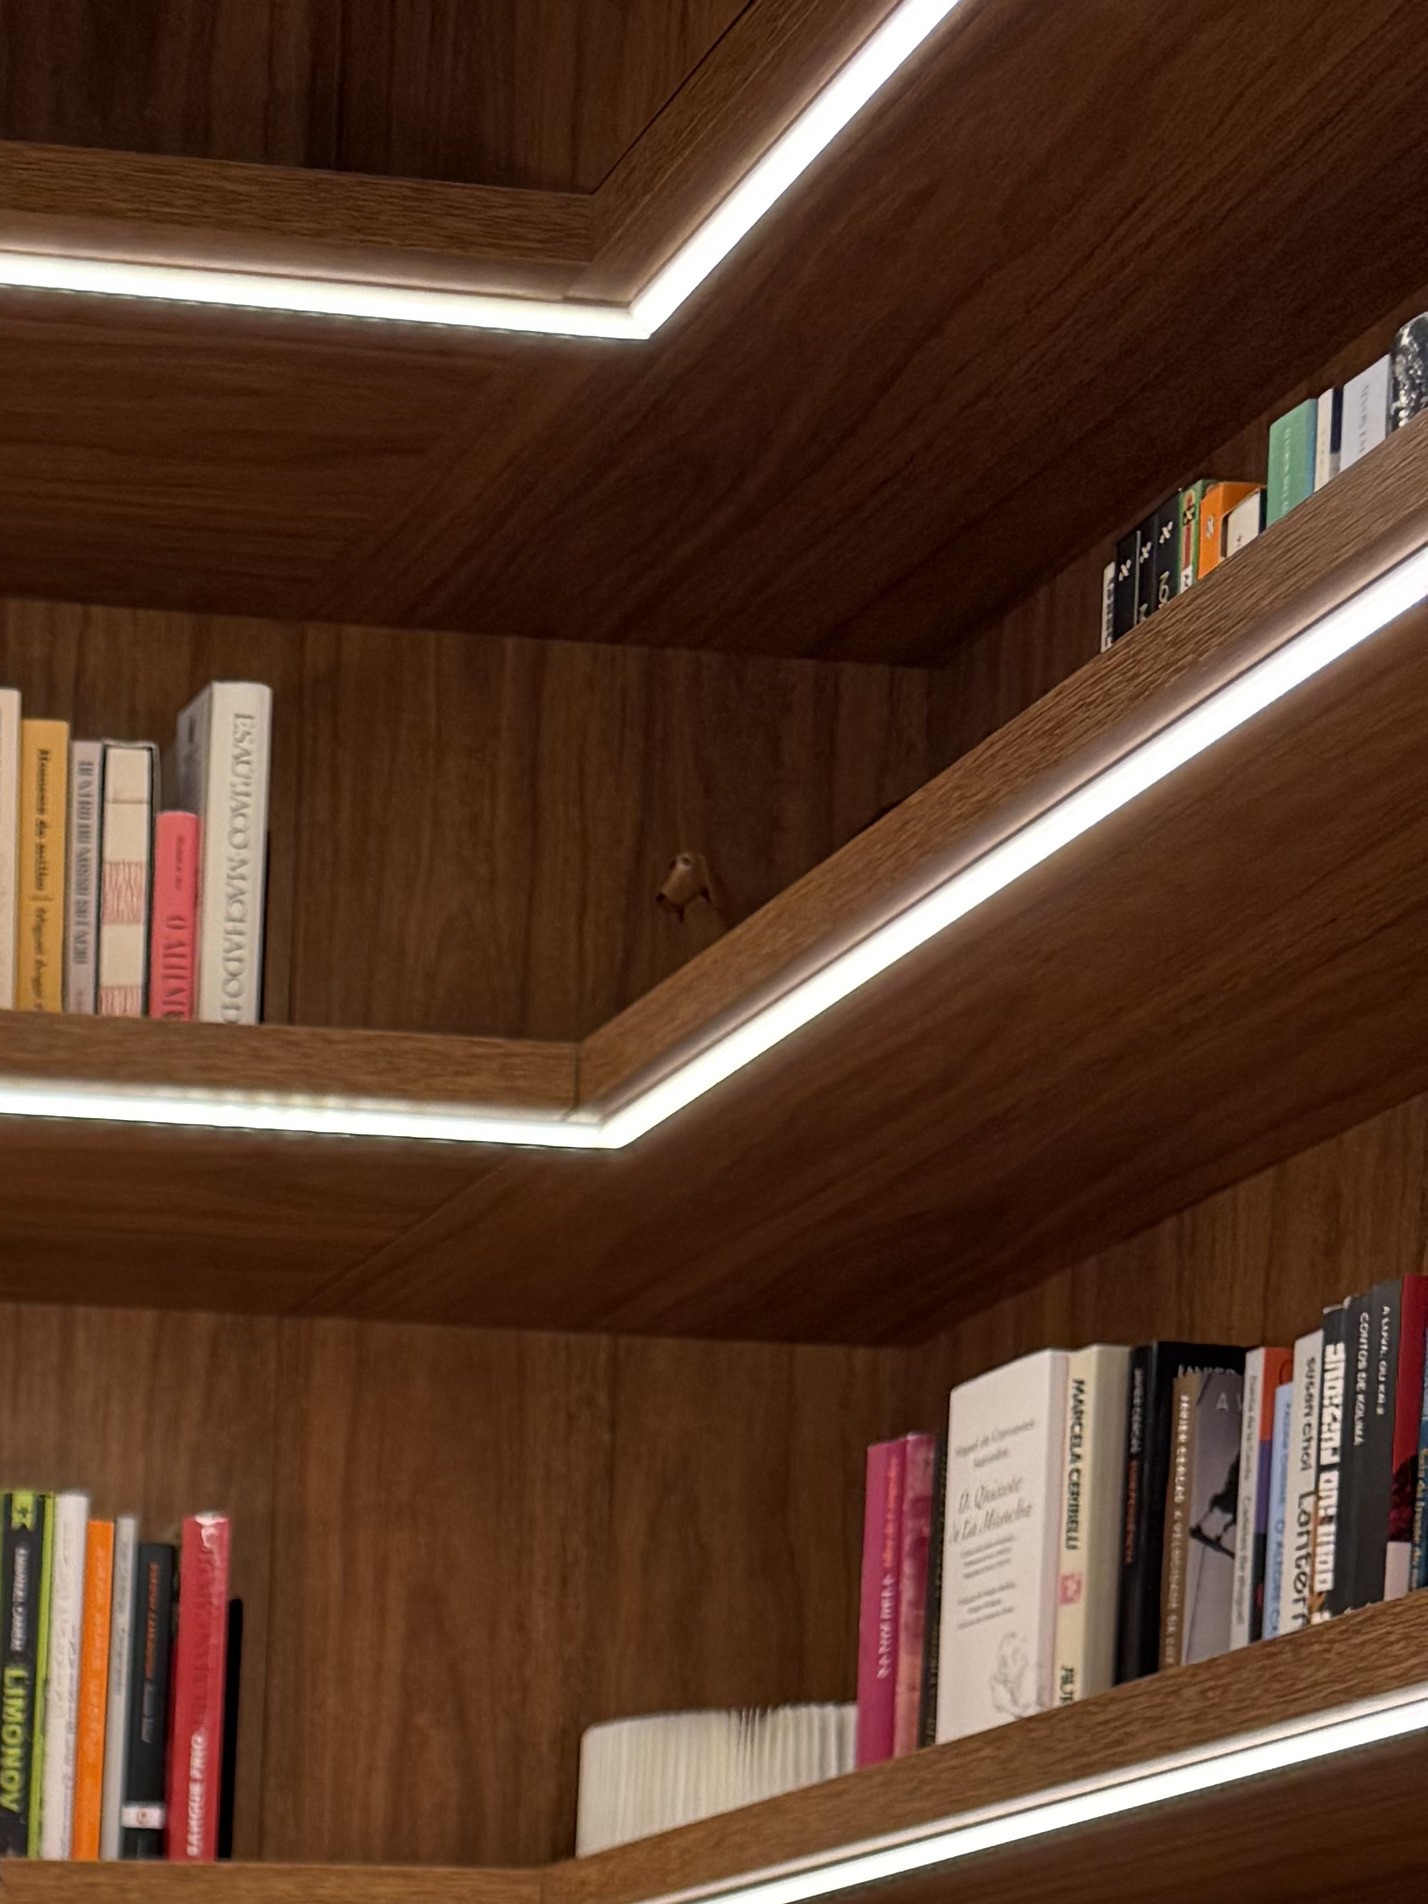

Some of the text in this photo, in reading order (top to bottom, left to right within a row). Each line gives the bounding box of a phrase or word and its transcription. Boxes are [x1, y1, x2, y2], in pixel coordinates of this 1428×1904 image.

[223, 857, 250, 999] MACHADO
[1300, 1355, 1319, 1420] susan
[1352, 1311, 1370, 1447] CONTOS DE KOLIMÁ
[1176, 1394, 1191, 1443] JAVIER
[1298, 1421, 1316, 1472] choi
[1065, 1377, 1087, 1551] MARCELA CERIBELLI
[1173, 1446, 1188, 1505] CERCAS
[185, 1782, 206, 1859] SANGUE
